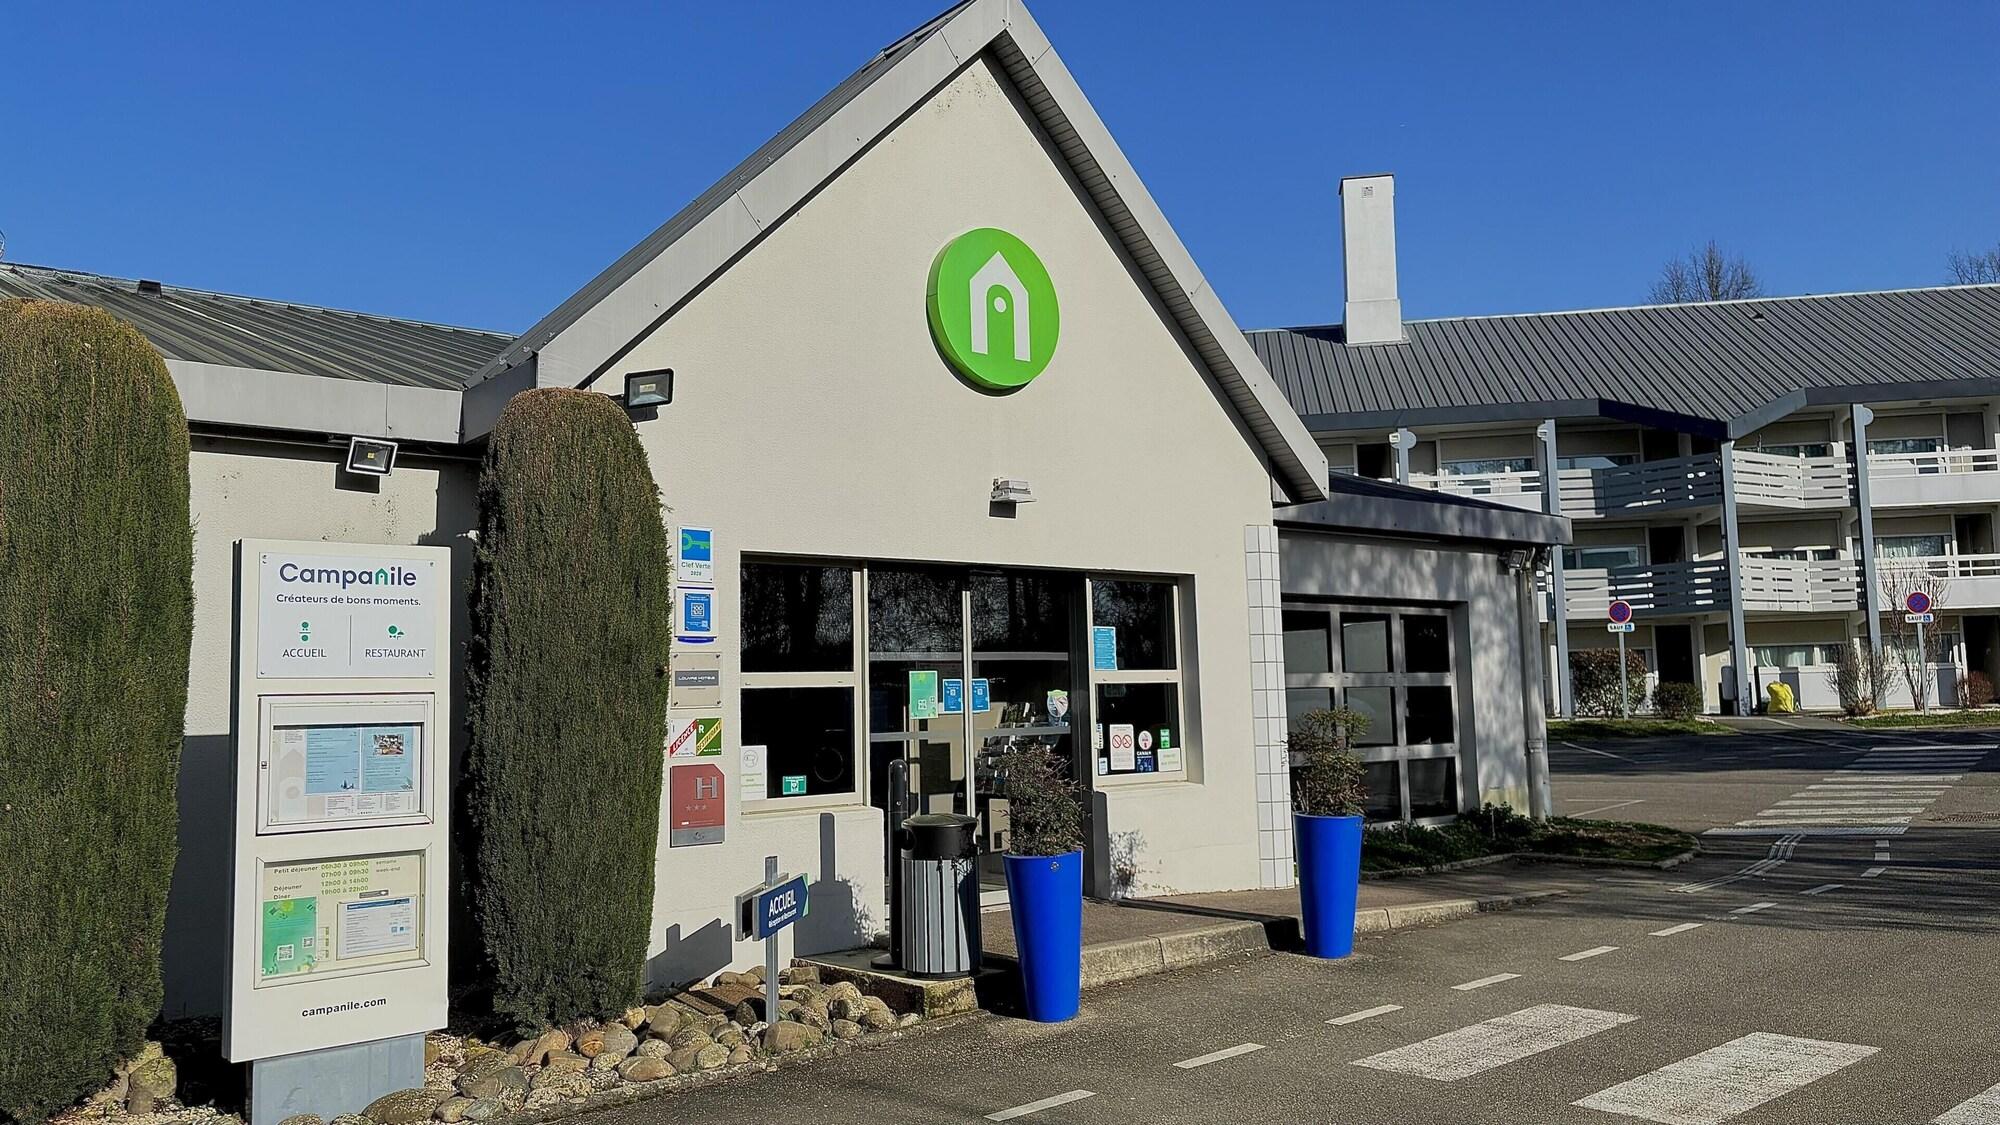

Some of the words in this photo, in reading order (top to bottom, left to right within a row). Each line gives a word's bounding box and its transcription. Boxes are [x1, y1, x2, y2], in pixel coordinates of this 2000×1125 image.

[279, 562, 417, 590] Campanile
[276, 593, 328, 604] Créateurs
[330, 594, 344, 604] de
[346, 595, 371, 605] bons
[373, 596, 421, 606] moments.
[282, 648, 327, 658] ACCUEIL
[365, 648, 426, 659] RESTAURANT
[672, 723, 694, 752] LICENCE
[698, 724, 705, 733] R
[695, 777, 718, 800] H
[321, 879, 341, 887] 12h00
[769, 889, 796, 917] ACCUEIL
[302, 996, 387, 1018] campanile.com
